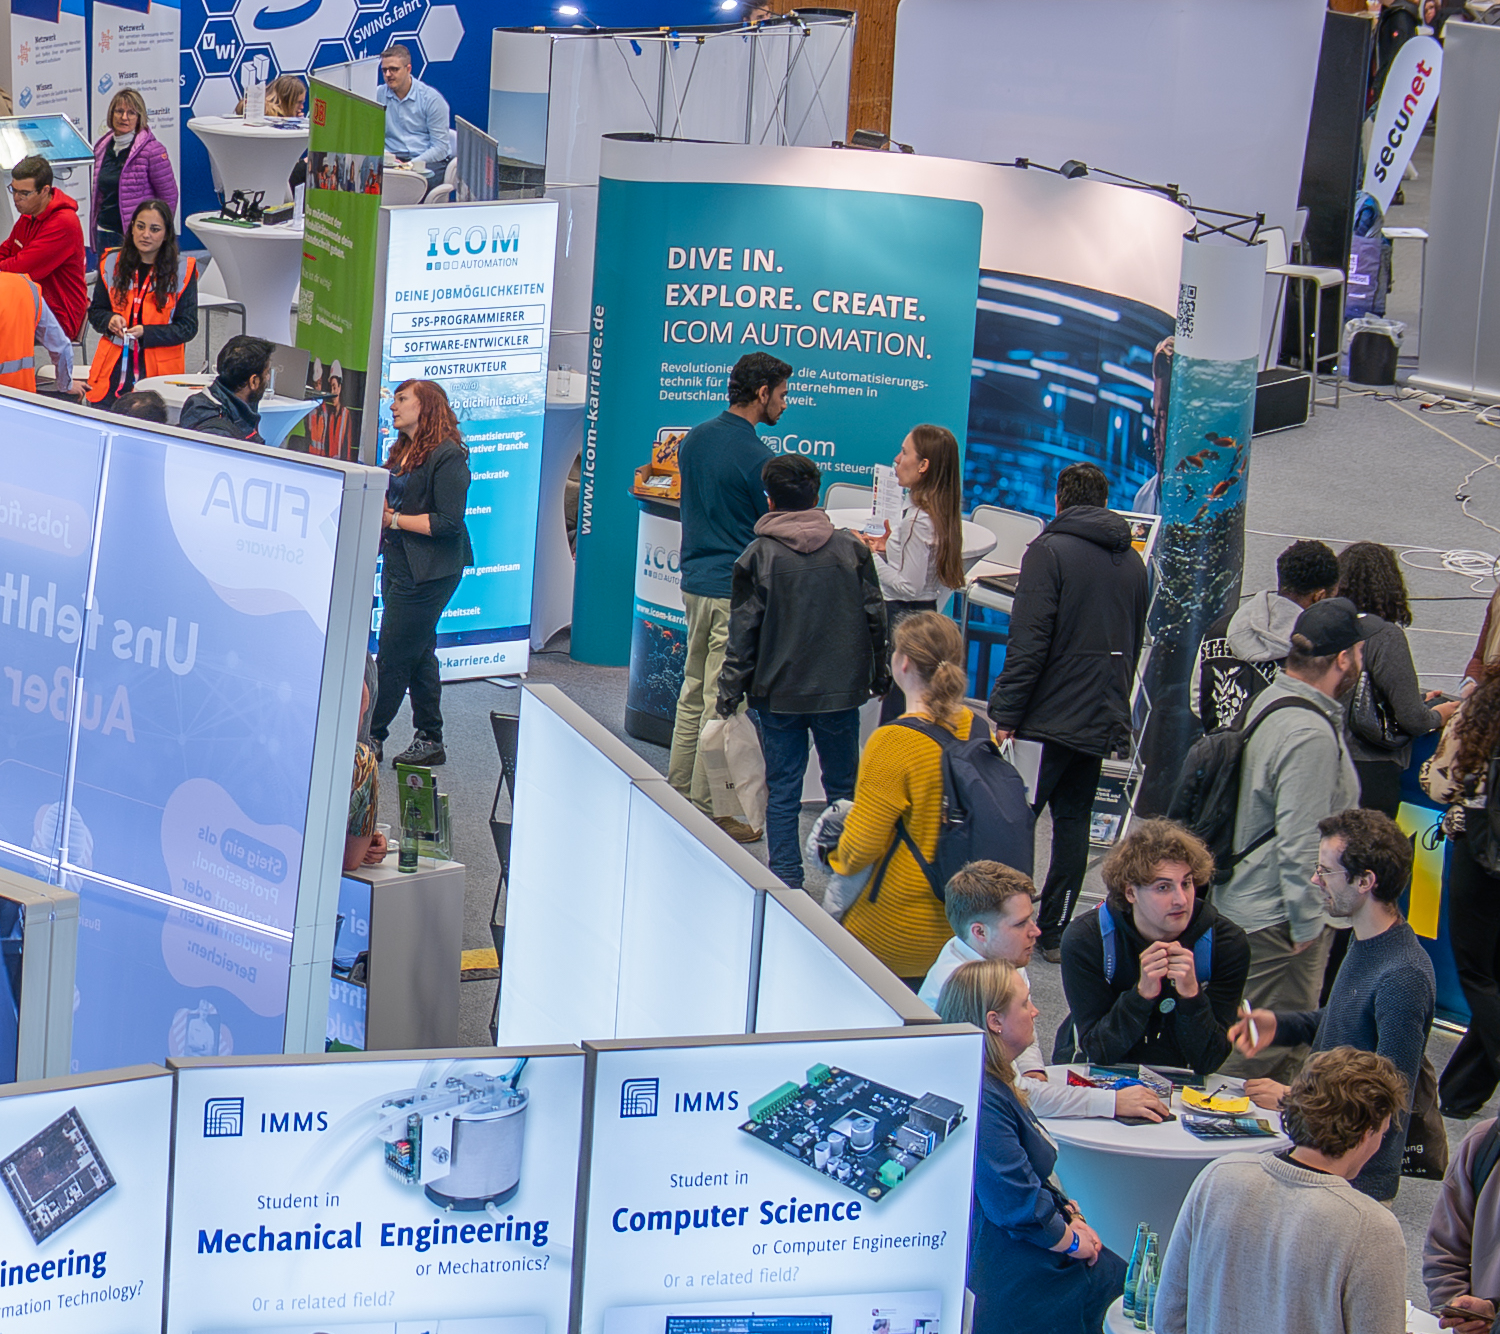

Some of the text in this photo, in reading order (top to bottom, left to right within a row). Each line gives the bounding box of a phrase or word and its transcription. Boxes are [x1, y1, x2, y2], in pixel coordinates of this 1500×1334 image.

[118, 23, 145, 32] Netzwerk
[1373, 59, 1433, 183] secunet
[427, 223, 519, 257] ICOM
[460, 257, 518, 269] AUTOMATION
[667, 246, 783, 273] DIVE IN.
[395, 282, 545, 303] DEINE JOBMÖGLICHKEITEN
[665, 284, 927, 322] EXPLORE. CREATE.
[411, 310, 525, 327] SPS-PROGRAMMIERER
[404, 334, 529, 354] SOFTWARE-ENTWICKLER
[663, 320, 933, 360] ICOM AUTOMATION.
[424, 360, 507, 376] KONSTRUKTEUR
[798, 368, 928, 390] die Automatisierungs-
[660, 377, 724, 387] technik für
[486, 394, 528, 407] initiativ!
[581, 304, 606, 536] www.icom-karriere.de
[476, 563, 520, 576] gemeinsam
[674, 1090, 739, 1113] IMMS
[260, 1111, 328, 1134] IMMS
[670, 1170, 749, 1188] Student in
[612, 1197, 862, 1236] Computer Science
[197, 1215, 549, 1255] Mechanical Engineering
[852, 1231, 947, 1254] Engineering?
[415, 1255, 550, 1276] or Mechatronics?
[57, 1280, 144, 1310] Technology?
